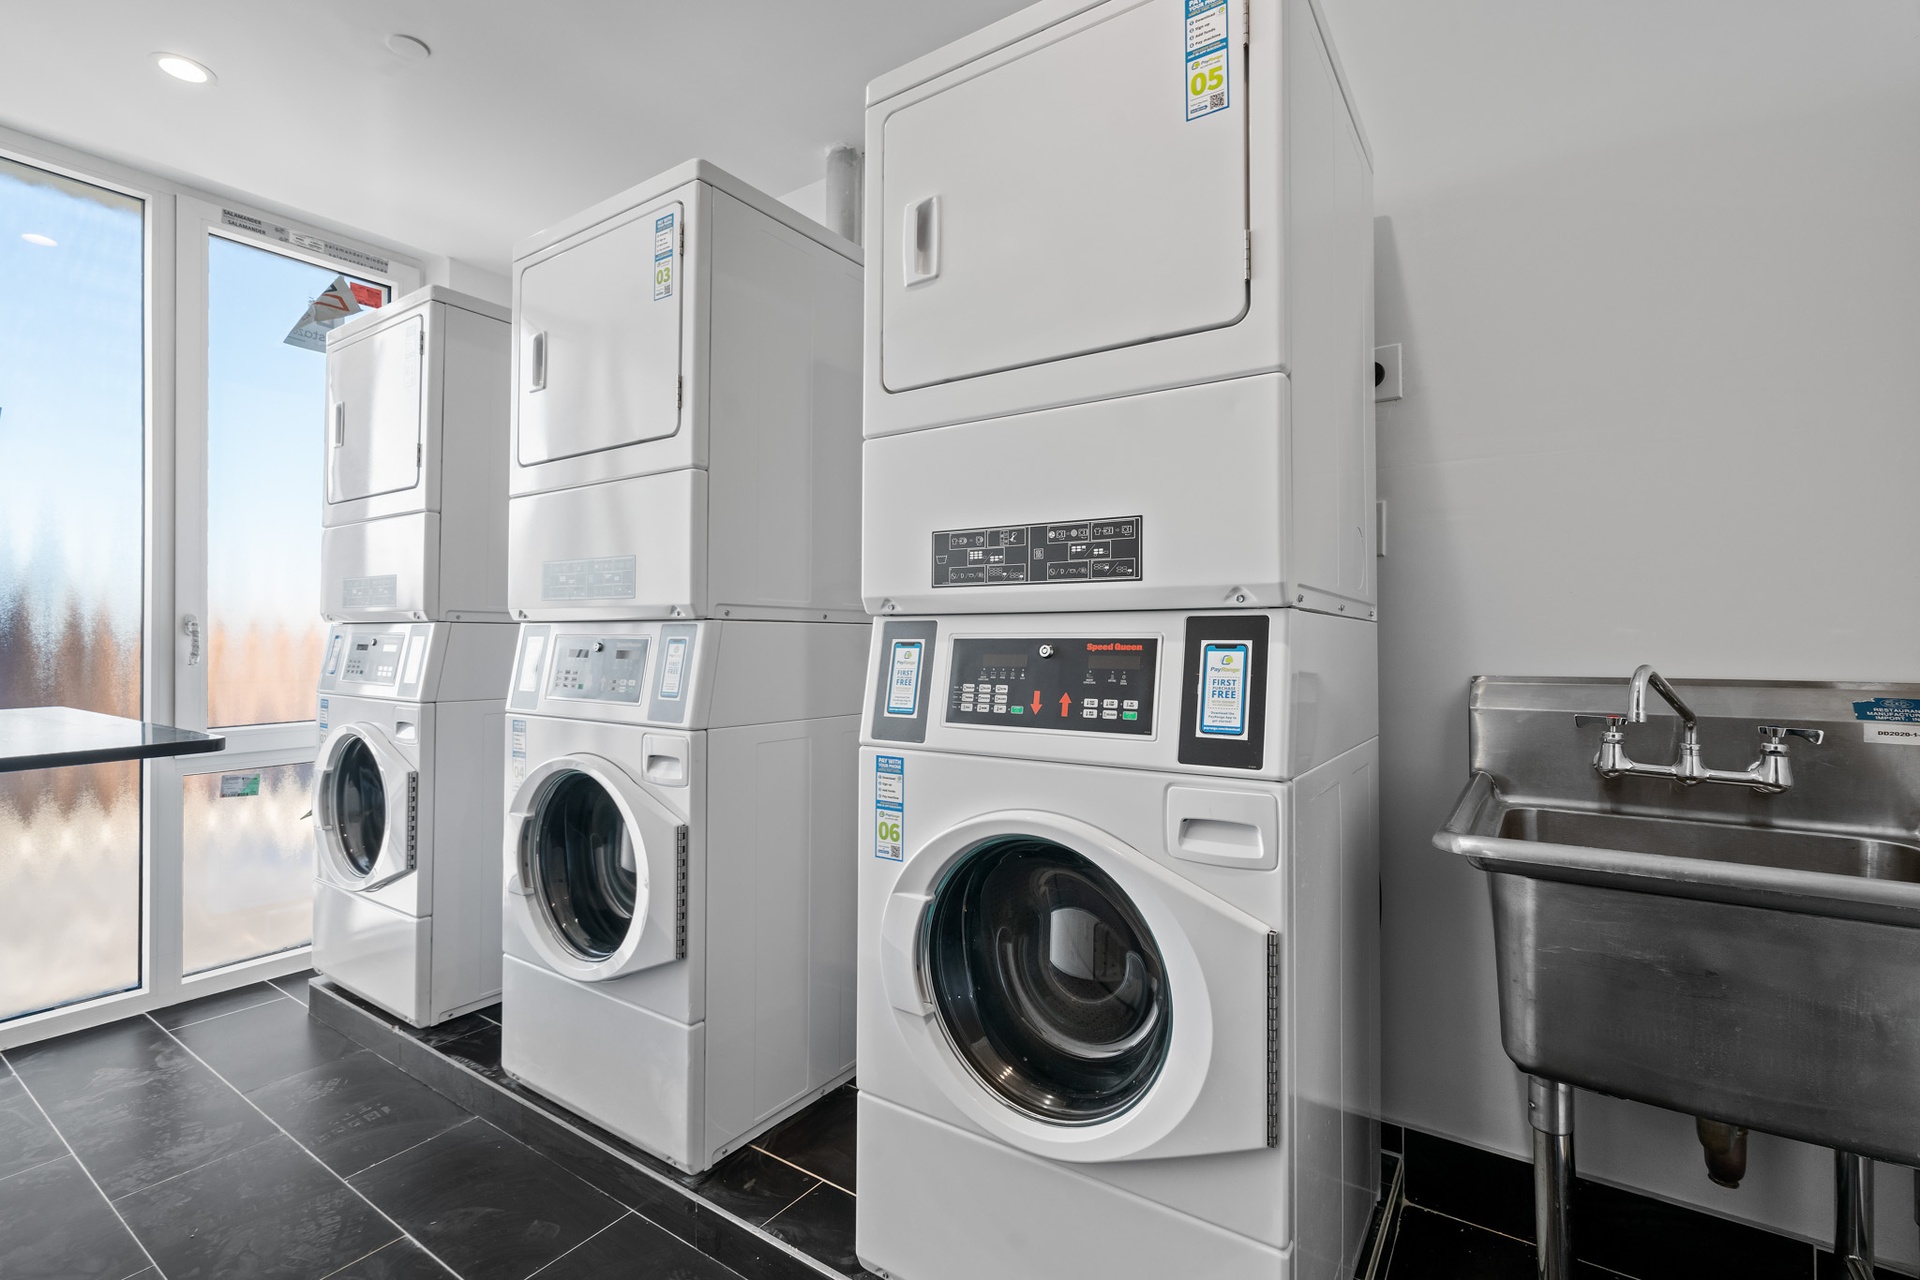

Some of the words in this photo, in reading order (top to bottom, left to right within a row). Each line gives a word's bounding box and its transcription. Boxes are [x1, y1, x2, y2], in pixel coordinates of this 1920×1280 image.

[1191, 65, 1223, 96] 05
[223, 209, 262, 225] SALAMANDER
[228, 219, 266, 235] SALAMANDER
[656, 267, 671, 285] 03
[1086, 643, 1114, 652] Speed
[1115, 643, 1143, 651] Queen
[1212, 679, 1237, 687] FIRST
[1211, 690, 1237, 699] FREE
[878, 821, 900, 843] 06
